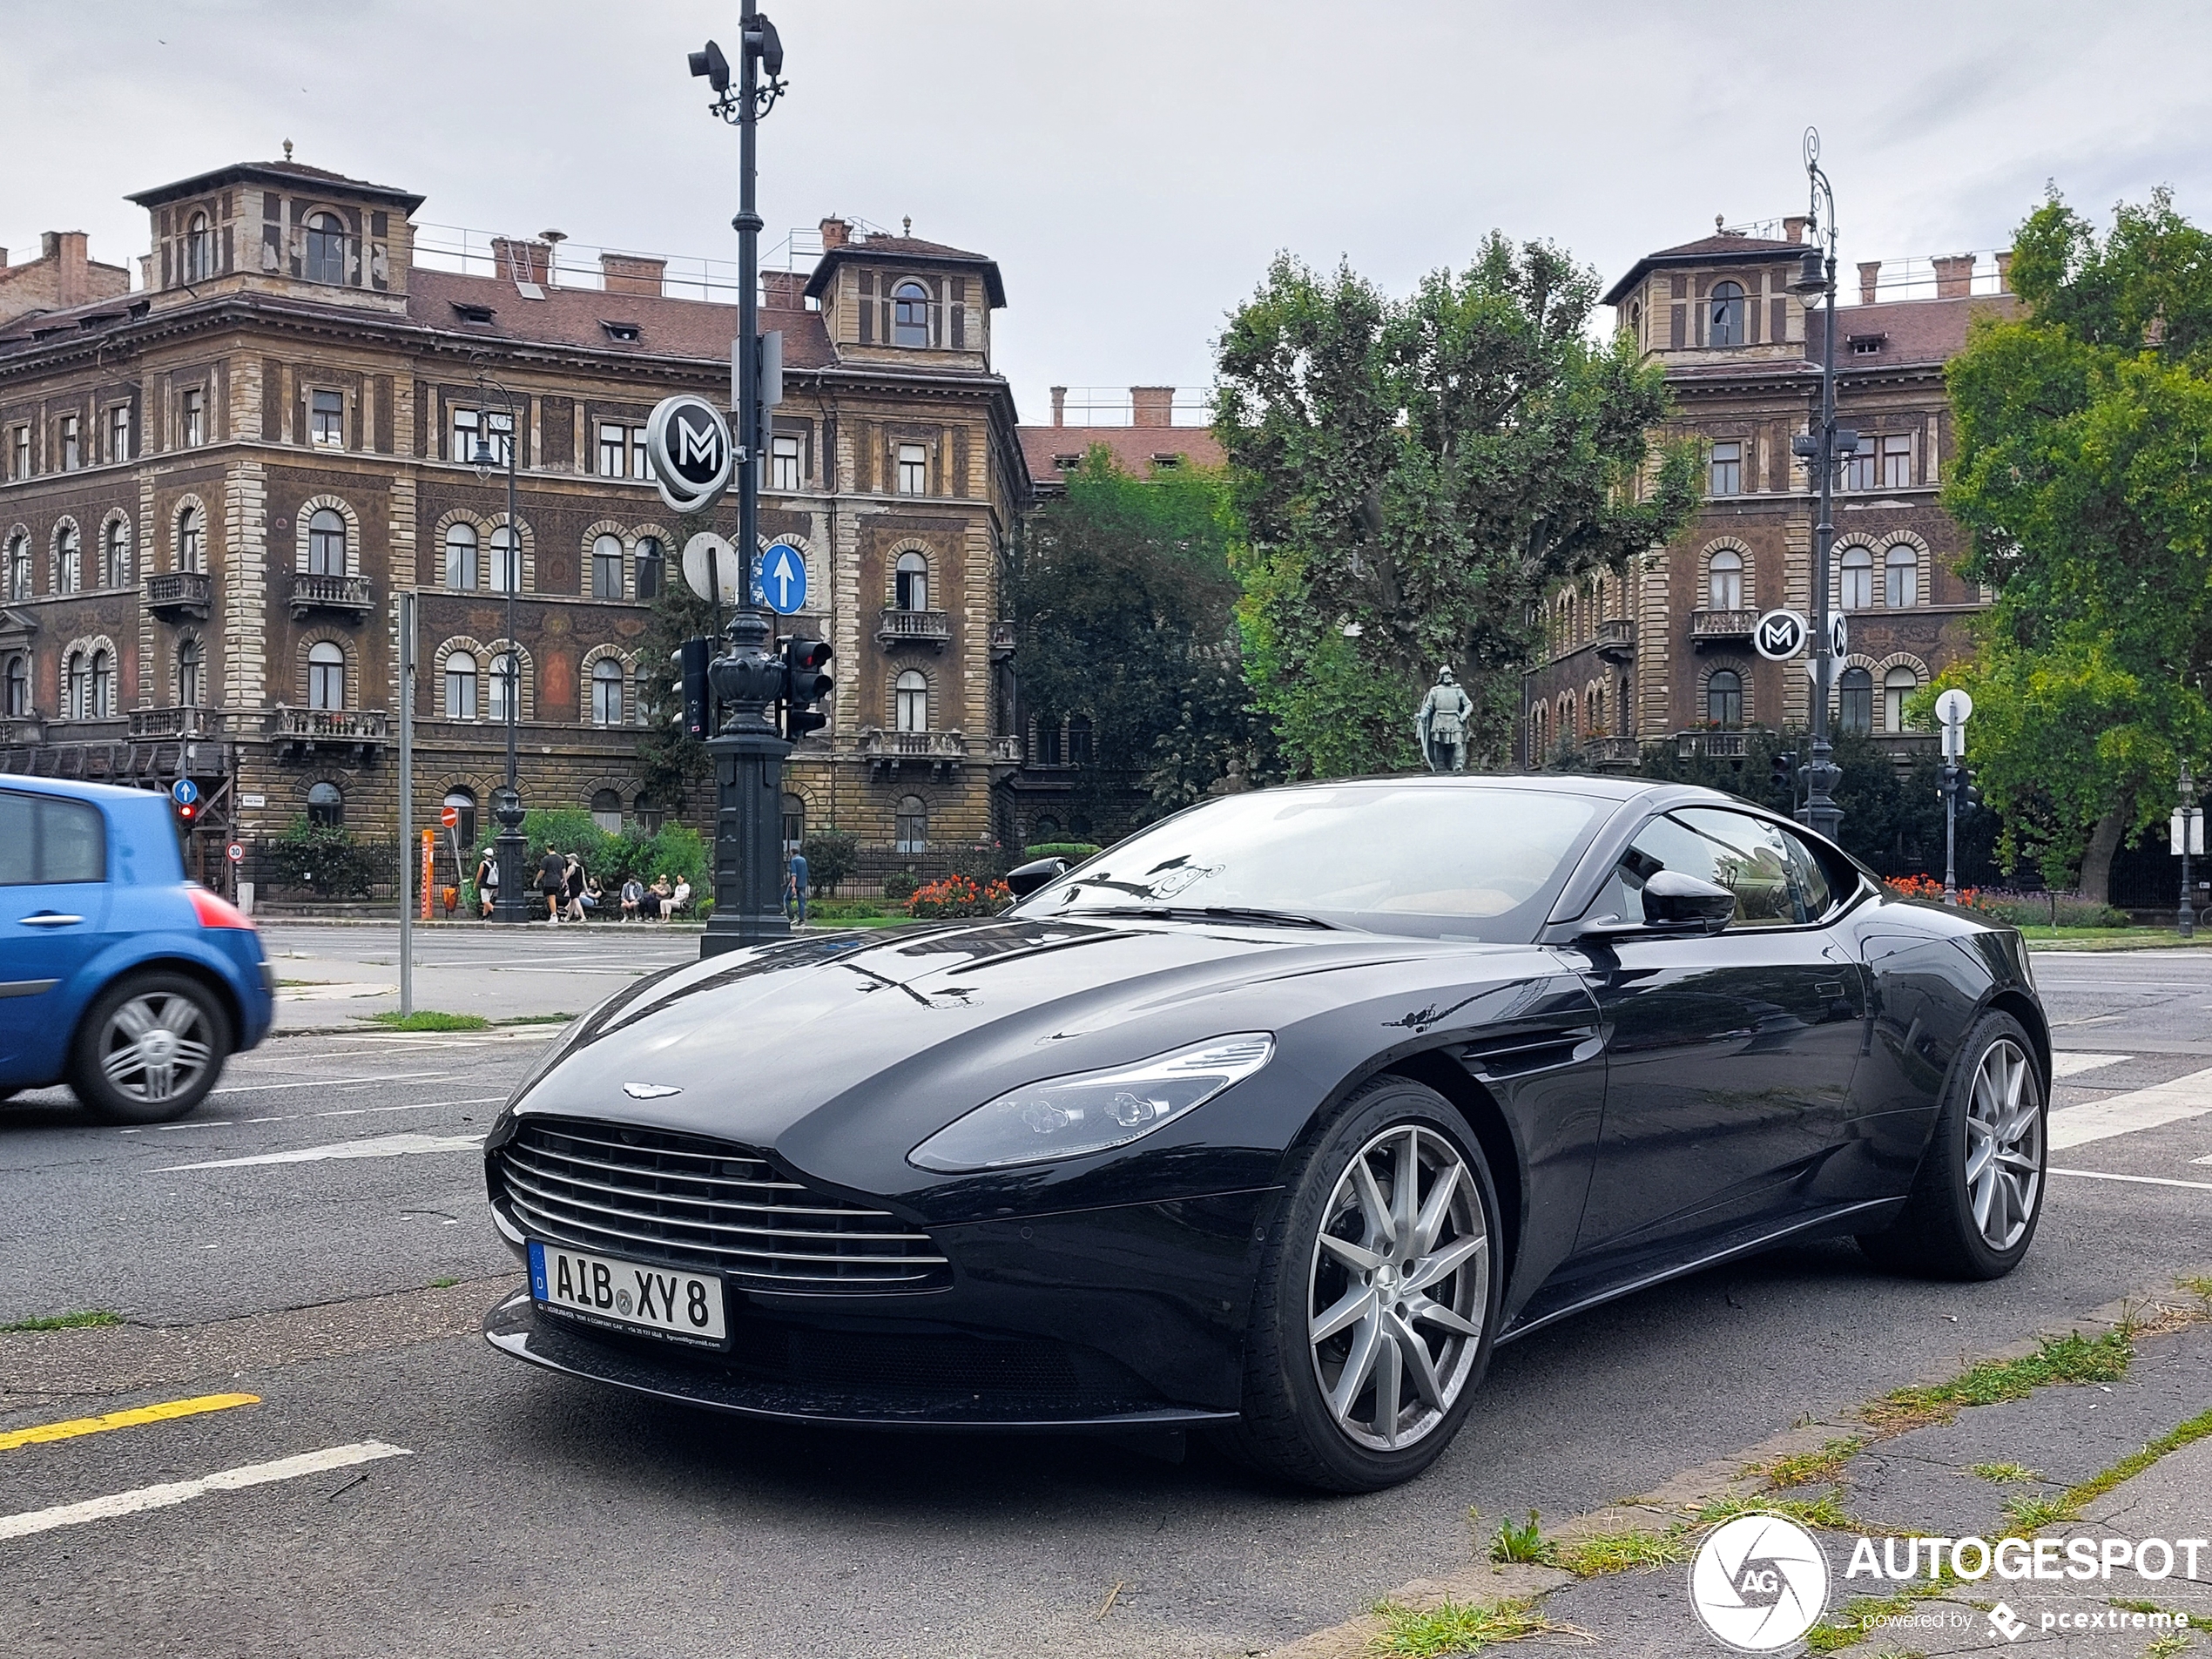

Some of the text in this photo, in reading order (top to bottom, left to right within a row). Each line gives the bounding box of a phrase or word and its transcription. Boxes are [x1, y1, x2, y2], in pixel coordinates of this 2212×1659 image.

[678, 415, 717, 471] M
[1764, 620, 1792, 649] M
[231, 847, 240, 856] 30
[536, 1278, 543, 1290] D
[557, 1255, 613, 1309] AIB
